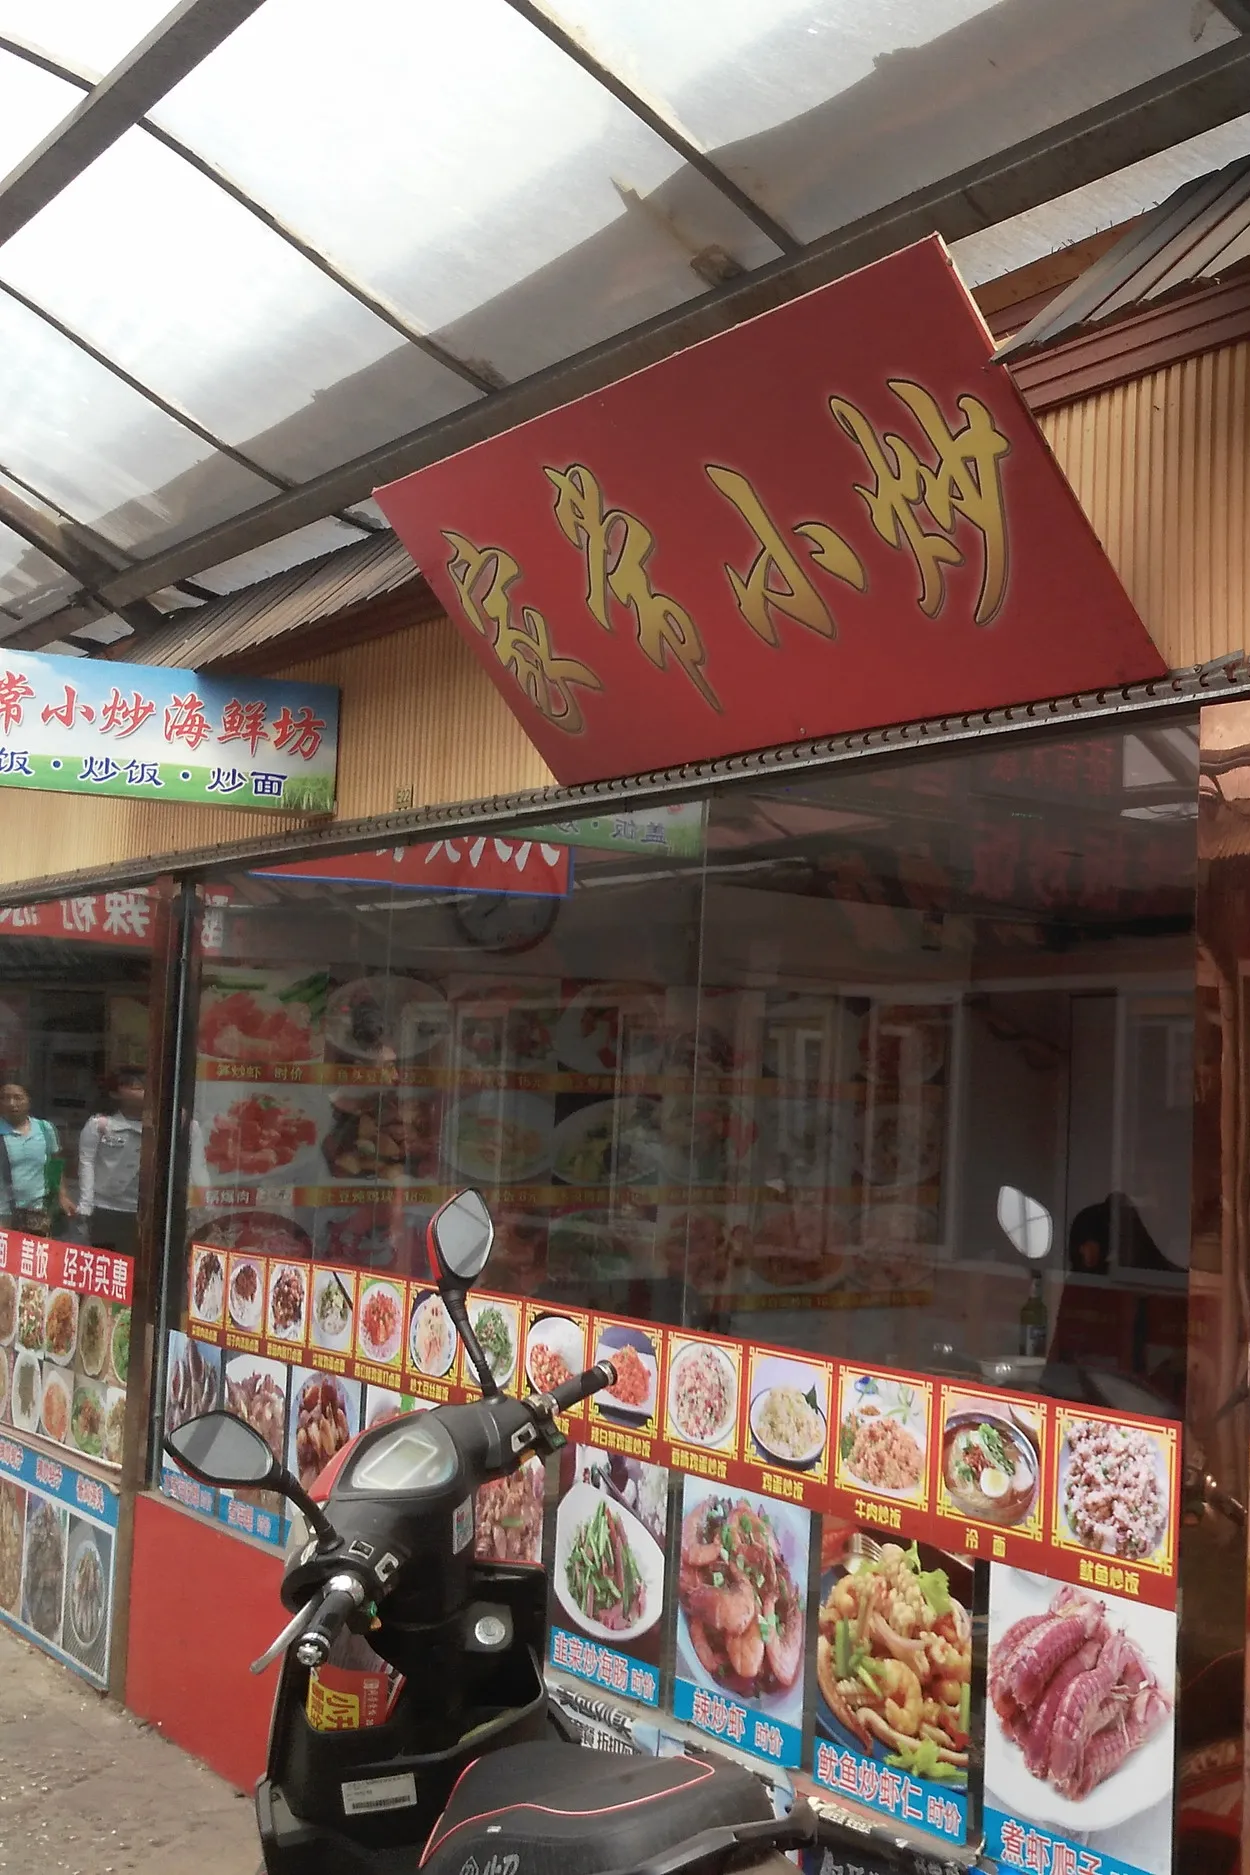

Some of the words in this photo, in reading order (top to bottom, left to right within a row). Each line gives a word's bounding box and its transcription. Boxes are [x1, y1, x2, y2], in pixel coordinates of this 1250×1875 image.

[0, 669, 328, 763] 常小炒海鲜坊
[21, 1238, 49, 1280] 盖饭
[63, 1247, 128, 1300] 经济实惠
[762, 1472, 805, 1501] 鸡蛋炒饭
[854, 1498, 902, 1530] 牛肉炒饭
[1079, 1558, 1141, 1596] 鱿鱼炒饭
[553, 1631, 629, 1694] 韭菜炒海肠
[631, 1667, 656, 1701] 时价
[692, 1687, 748, 1743] 辣炒虾
[754, 1719, 784, 1759] 时价
[817, 1742, 924, 1821] 鱿鱼炒虾仁
[926, 1795, 962, 1837] 时价
